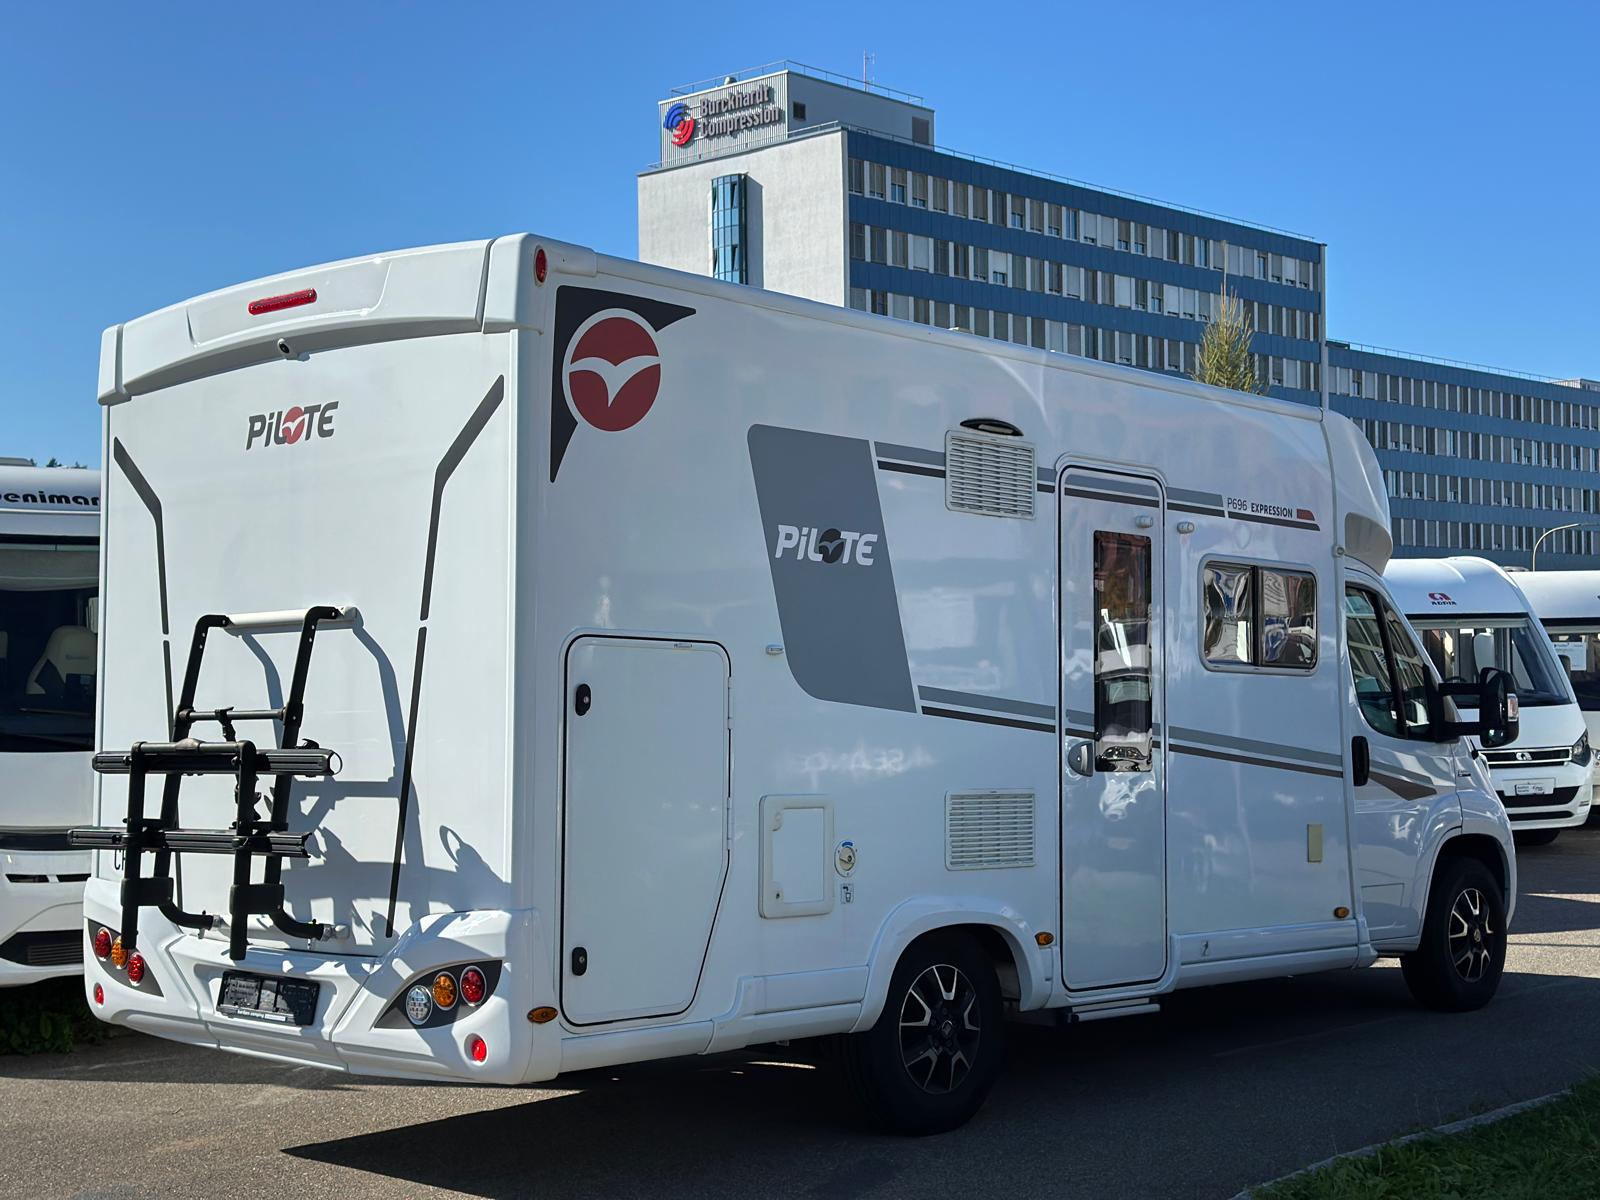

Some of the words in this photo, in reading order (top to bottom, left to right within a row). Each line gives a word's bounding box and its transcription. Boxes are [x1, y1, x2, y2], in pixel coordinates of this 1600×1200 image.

[700, 85, 769, 117] Burckhardt
[700, 105, 779, 138] Compression
[0, 490, 100, 506] enimar
[1227, 497, 1248, 511] P696
[1251, 502, 1293, 518] EXPRESSION
